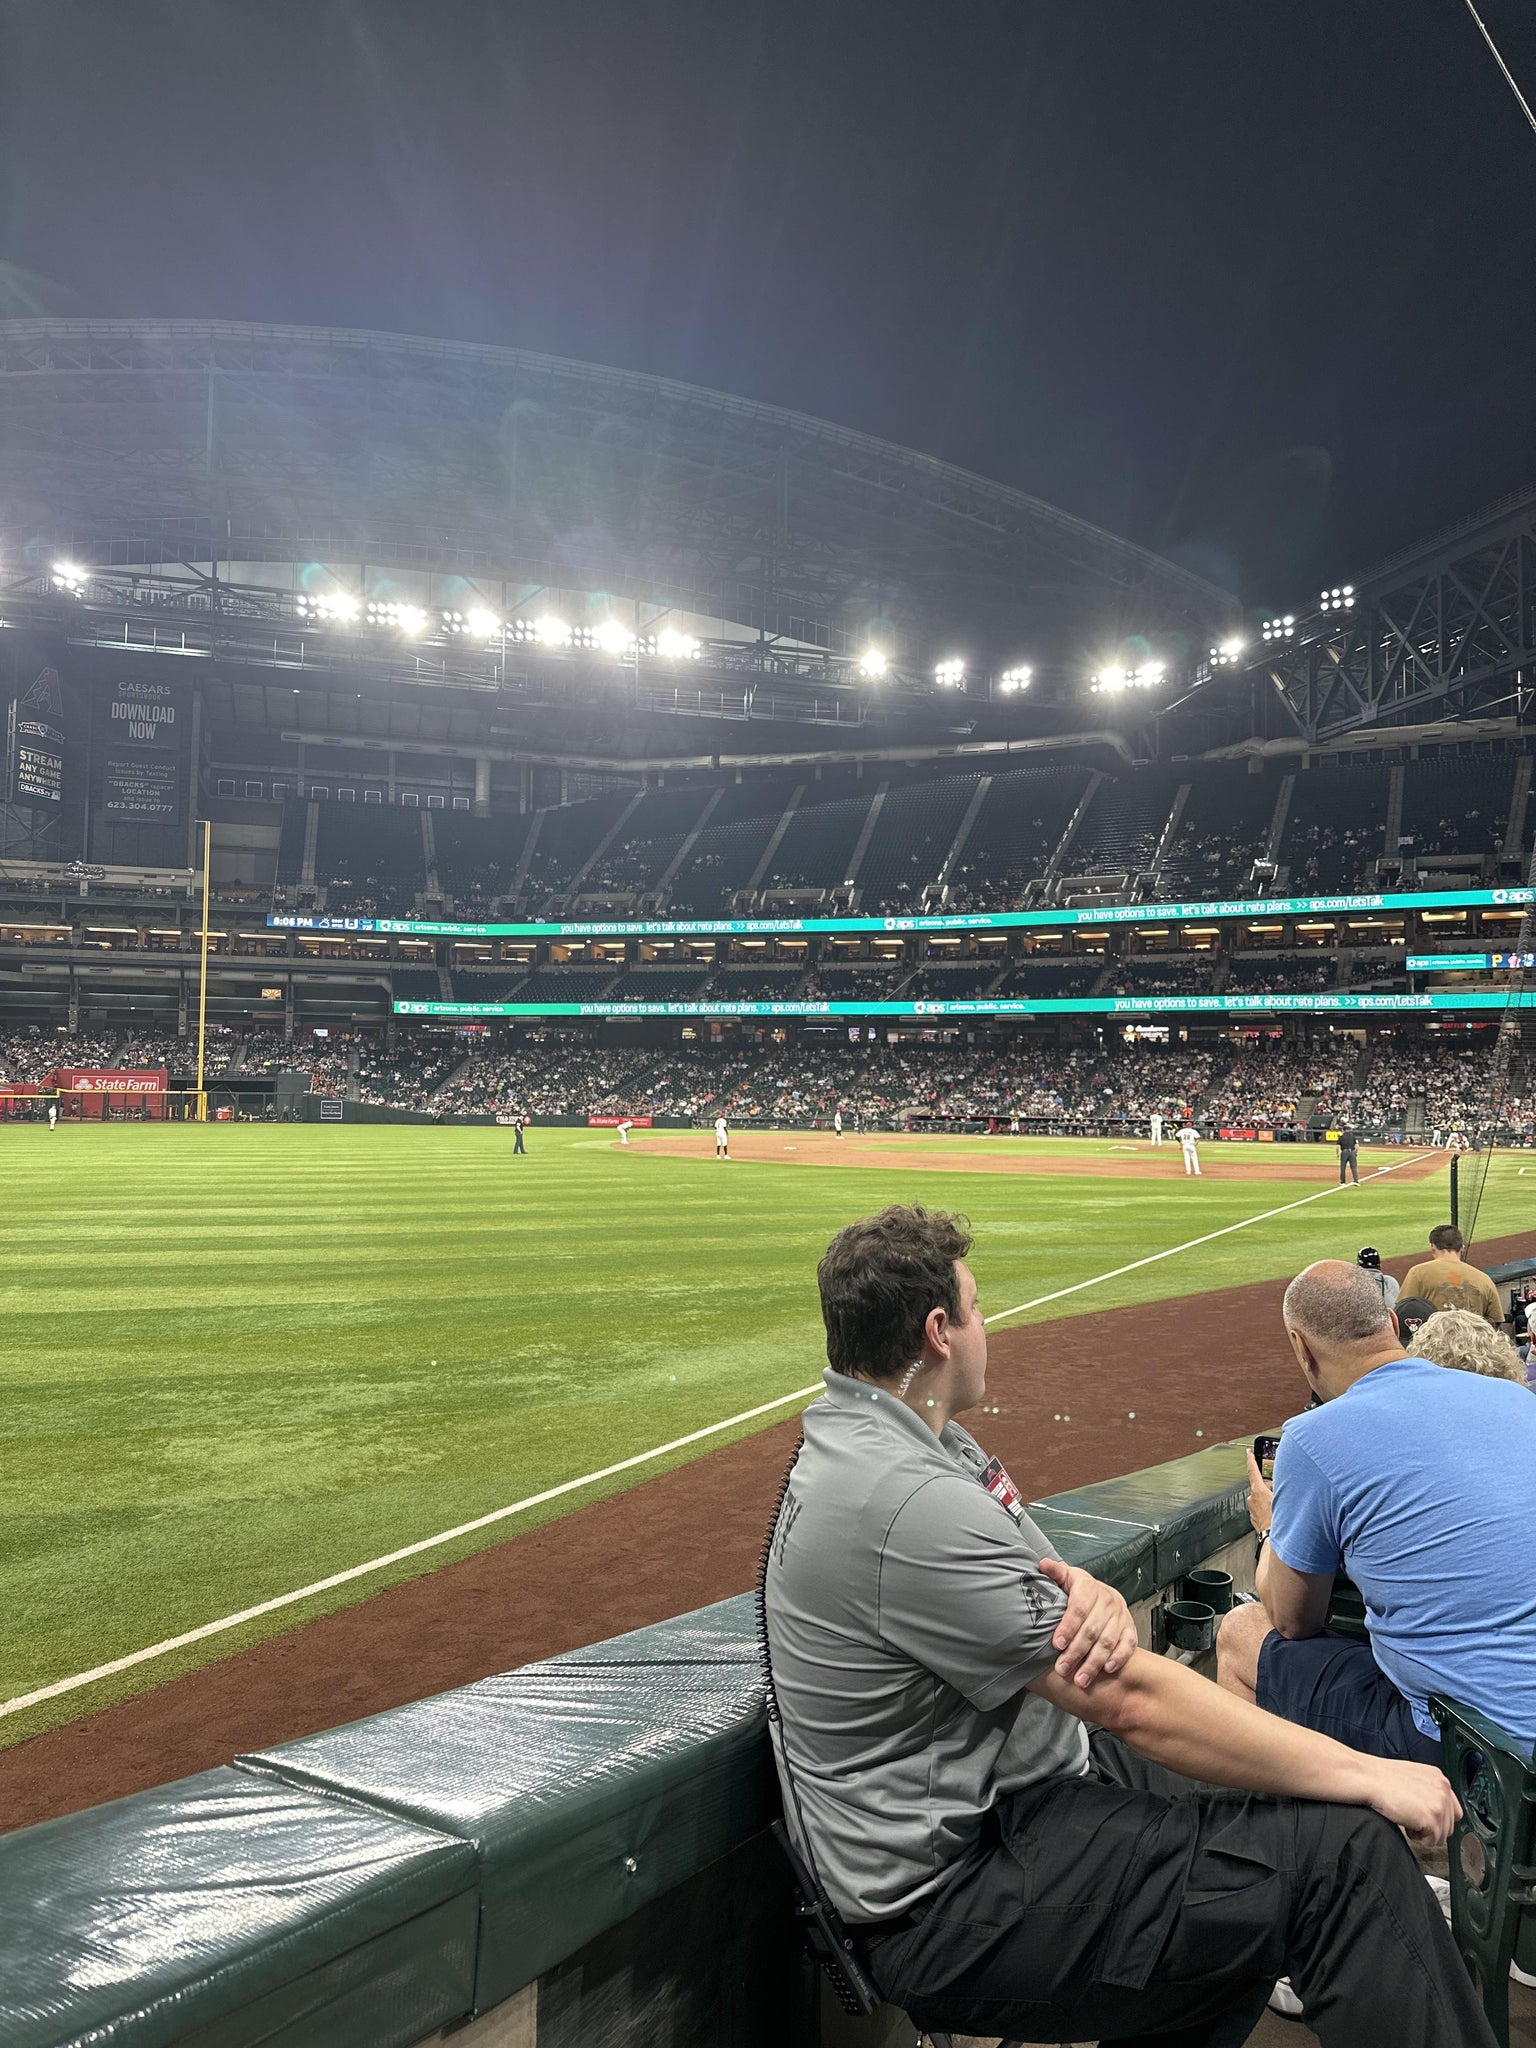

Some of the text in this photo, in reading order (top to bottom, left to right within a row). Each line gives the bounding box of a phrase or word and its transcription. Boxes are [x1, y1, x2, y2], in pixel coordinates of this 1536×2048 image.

[118, 682, 171, 695] CAESARS
[111, 702, 175, 724] DOWNLOAD
[129, 721, 156, 740] NOW
[20, 750, 62, 770] STREAM
[19, 762, 61, 780] ANY GAME
[19, 771, 61, 788] ANYWHERE
[122, 788, 160, 796] LOCATION
[107, 801, 173, 812] 623.304.0777
[1509, 891, 1535, 903] aps
[1077, 896, 1384, 923] you have options to save. let's talk about rate plans. aps.com/LetsTalk
[297, 917, 313, 927] PM
[392, 923, 410, 933] aps
[561, 924, 574, 935] you
[574, 923, 591, 932] have
[592, 923, 617, 934] options
[618, 923, 626, 932] to
[627, 924, 644, 932] save.
[646, 921, 662, 931] let's
[662, 921, 675, 931] talk
[676, 921, 696, 931] about
[697, 921, 713, 931] rate
[896, 920, 914, 929] aps
[1492, 954, 1503, 968] P
[410, 1004, 429, 1013] aps
[580, 1005, 593, 1015] you
[594, 1003, 611, 1012] have
[612, 1003, 638, 1014] options
[639, 1004, 646, 1012] to
[647, 1005, 666, 1013] save.
[667, 1002, 683, 1012] let's
[684, 1002, 698, 1012] talk
[699, 1002, 720, 1012] about
[720, 1003, 736, 1012] rate
[926, 1004, 945, 1014] aps
[1115, 994, 1433, 1011] you have options to save. let's talk about rate plans. aps.com/LetsTalk
